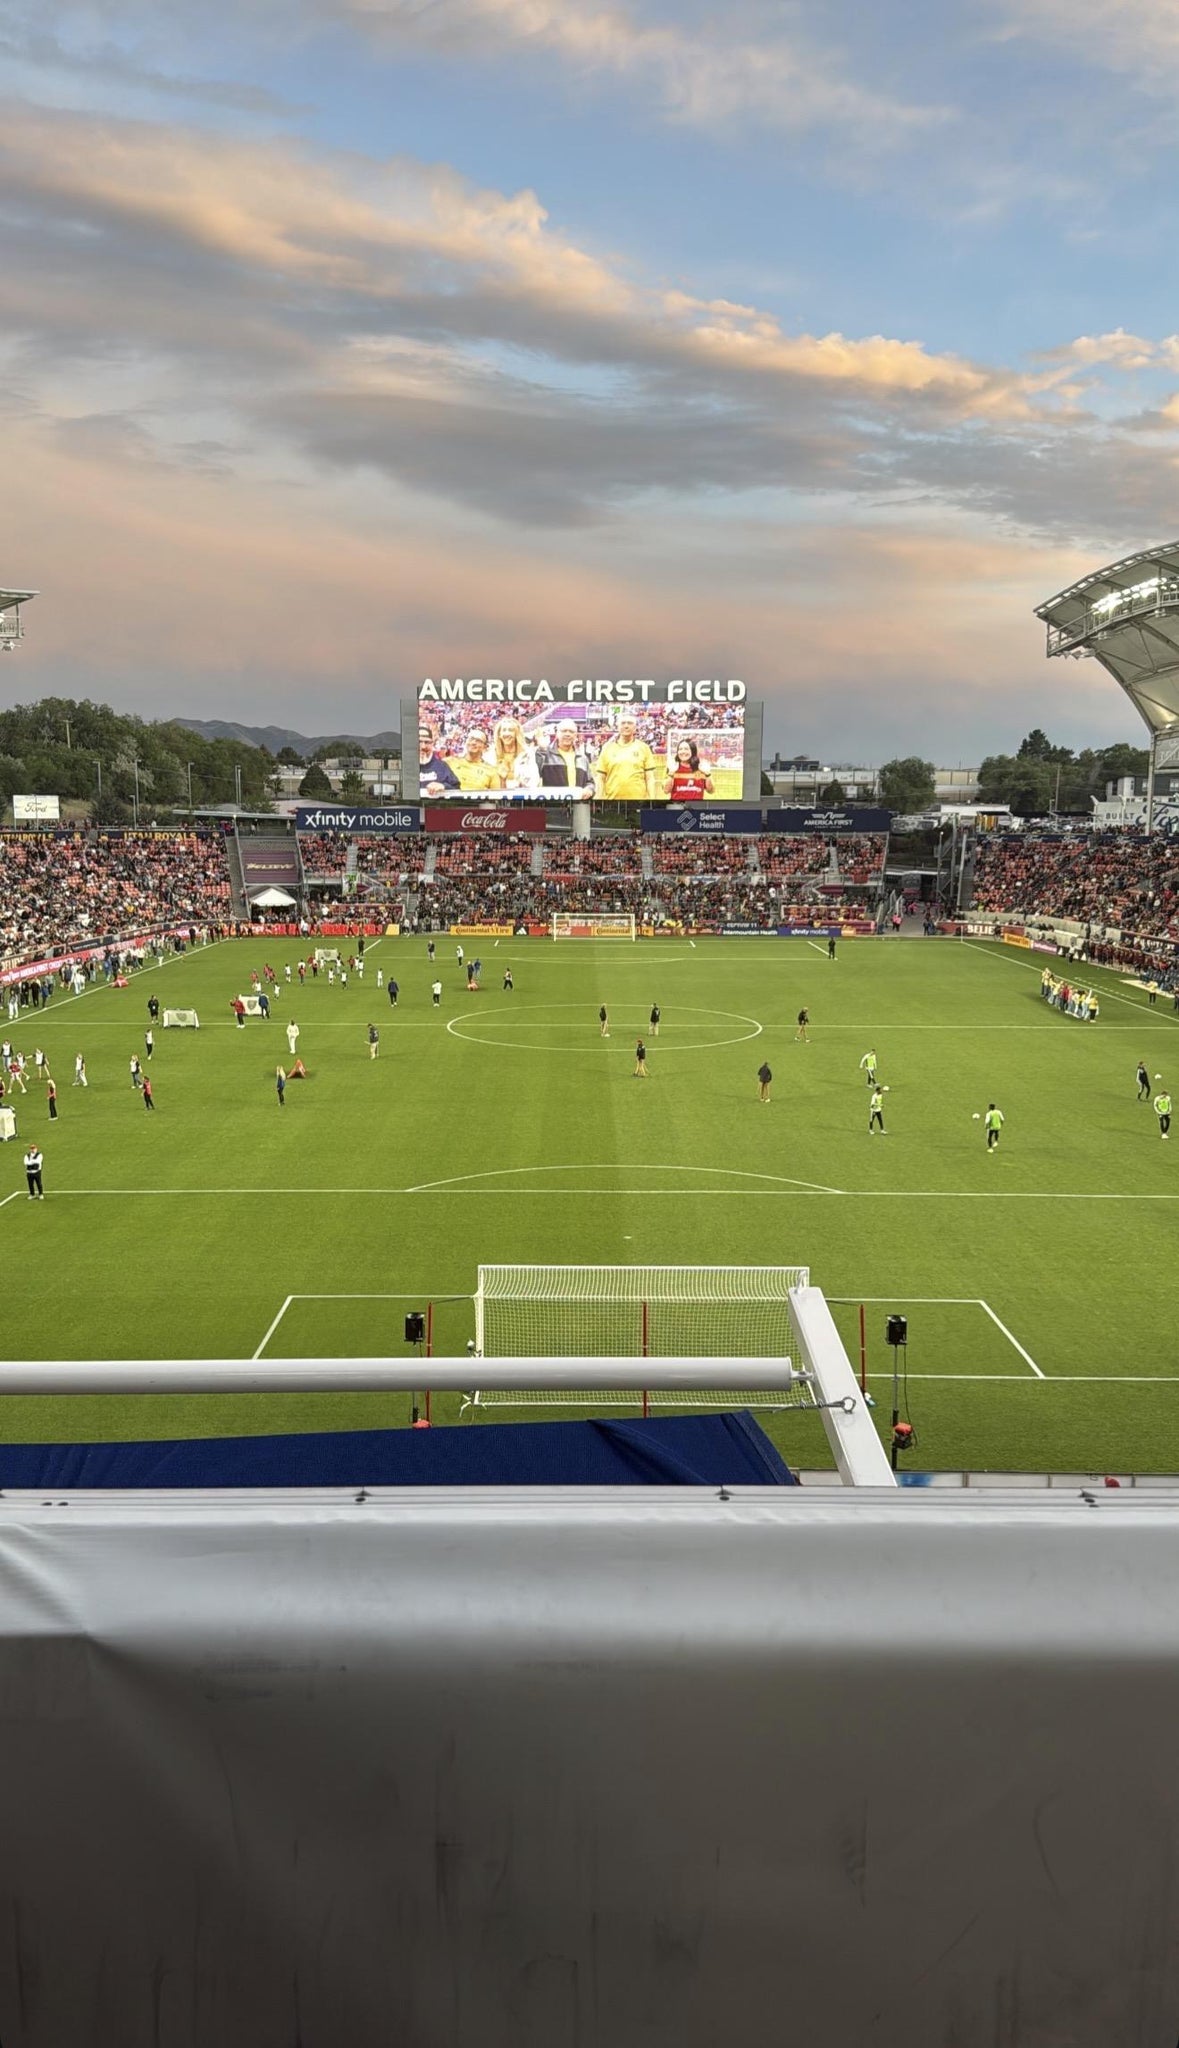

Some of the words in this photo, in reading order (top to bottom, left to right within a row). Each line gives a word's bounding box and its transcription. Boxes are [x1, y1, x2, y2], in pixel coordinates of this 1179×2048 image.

[418, 679, 554, 700] AMERICA
[567, 680, 655, 701] FIRST
[667, 680, 746, 701] FIELD
[24, 802, 47, 813] Ford
[305, 810, 346, 828] xfinity
[360, 811, 411, 826] mobile
[461, 812, 509, 828] Coca-Cola
[700, 812, 725, 821] Select
[699, 821, 725, 829] Health
[154, 832, 197, 841] ROYALS
